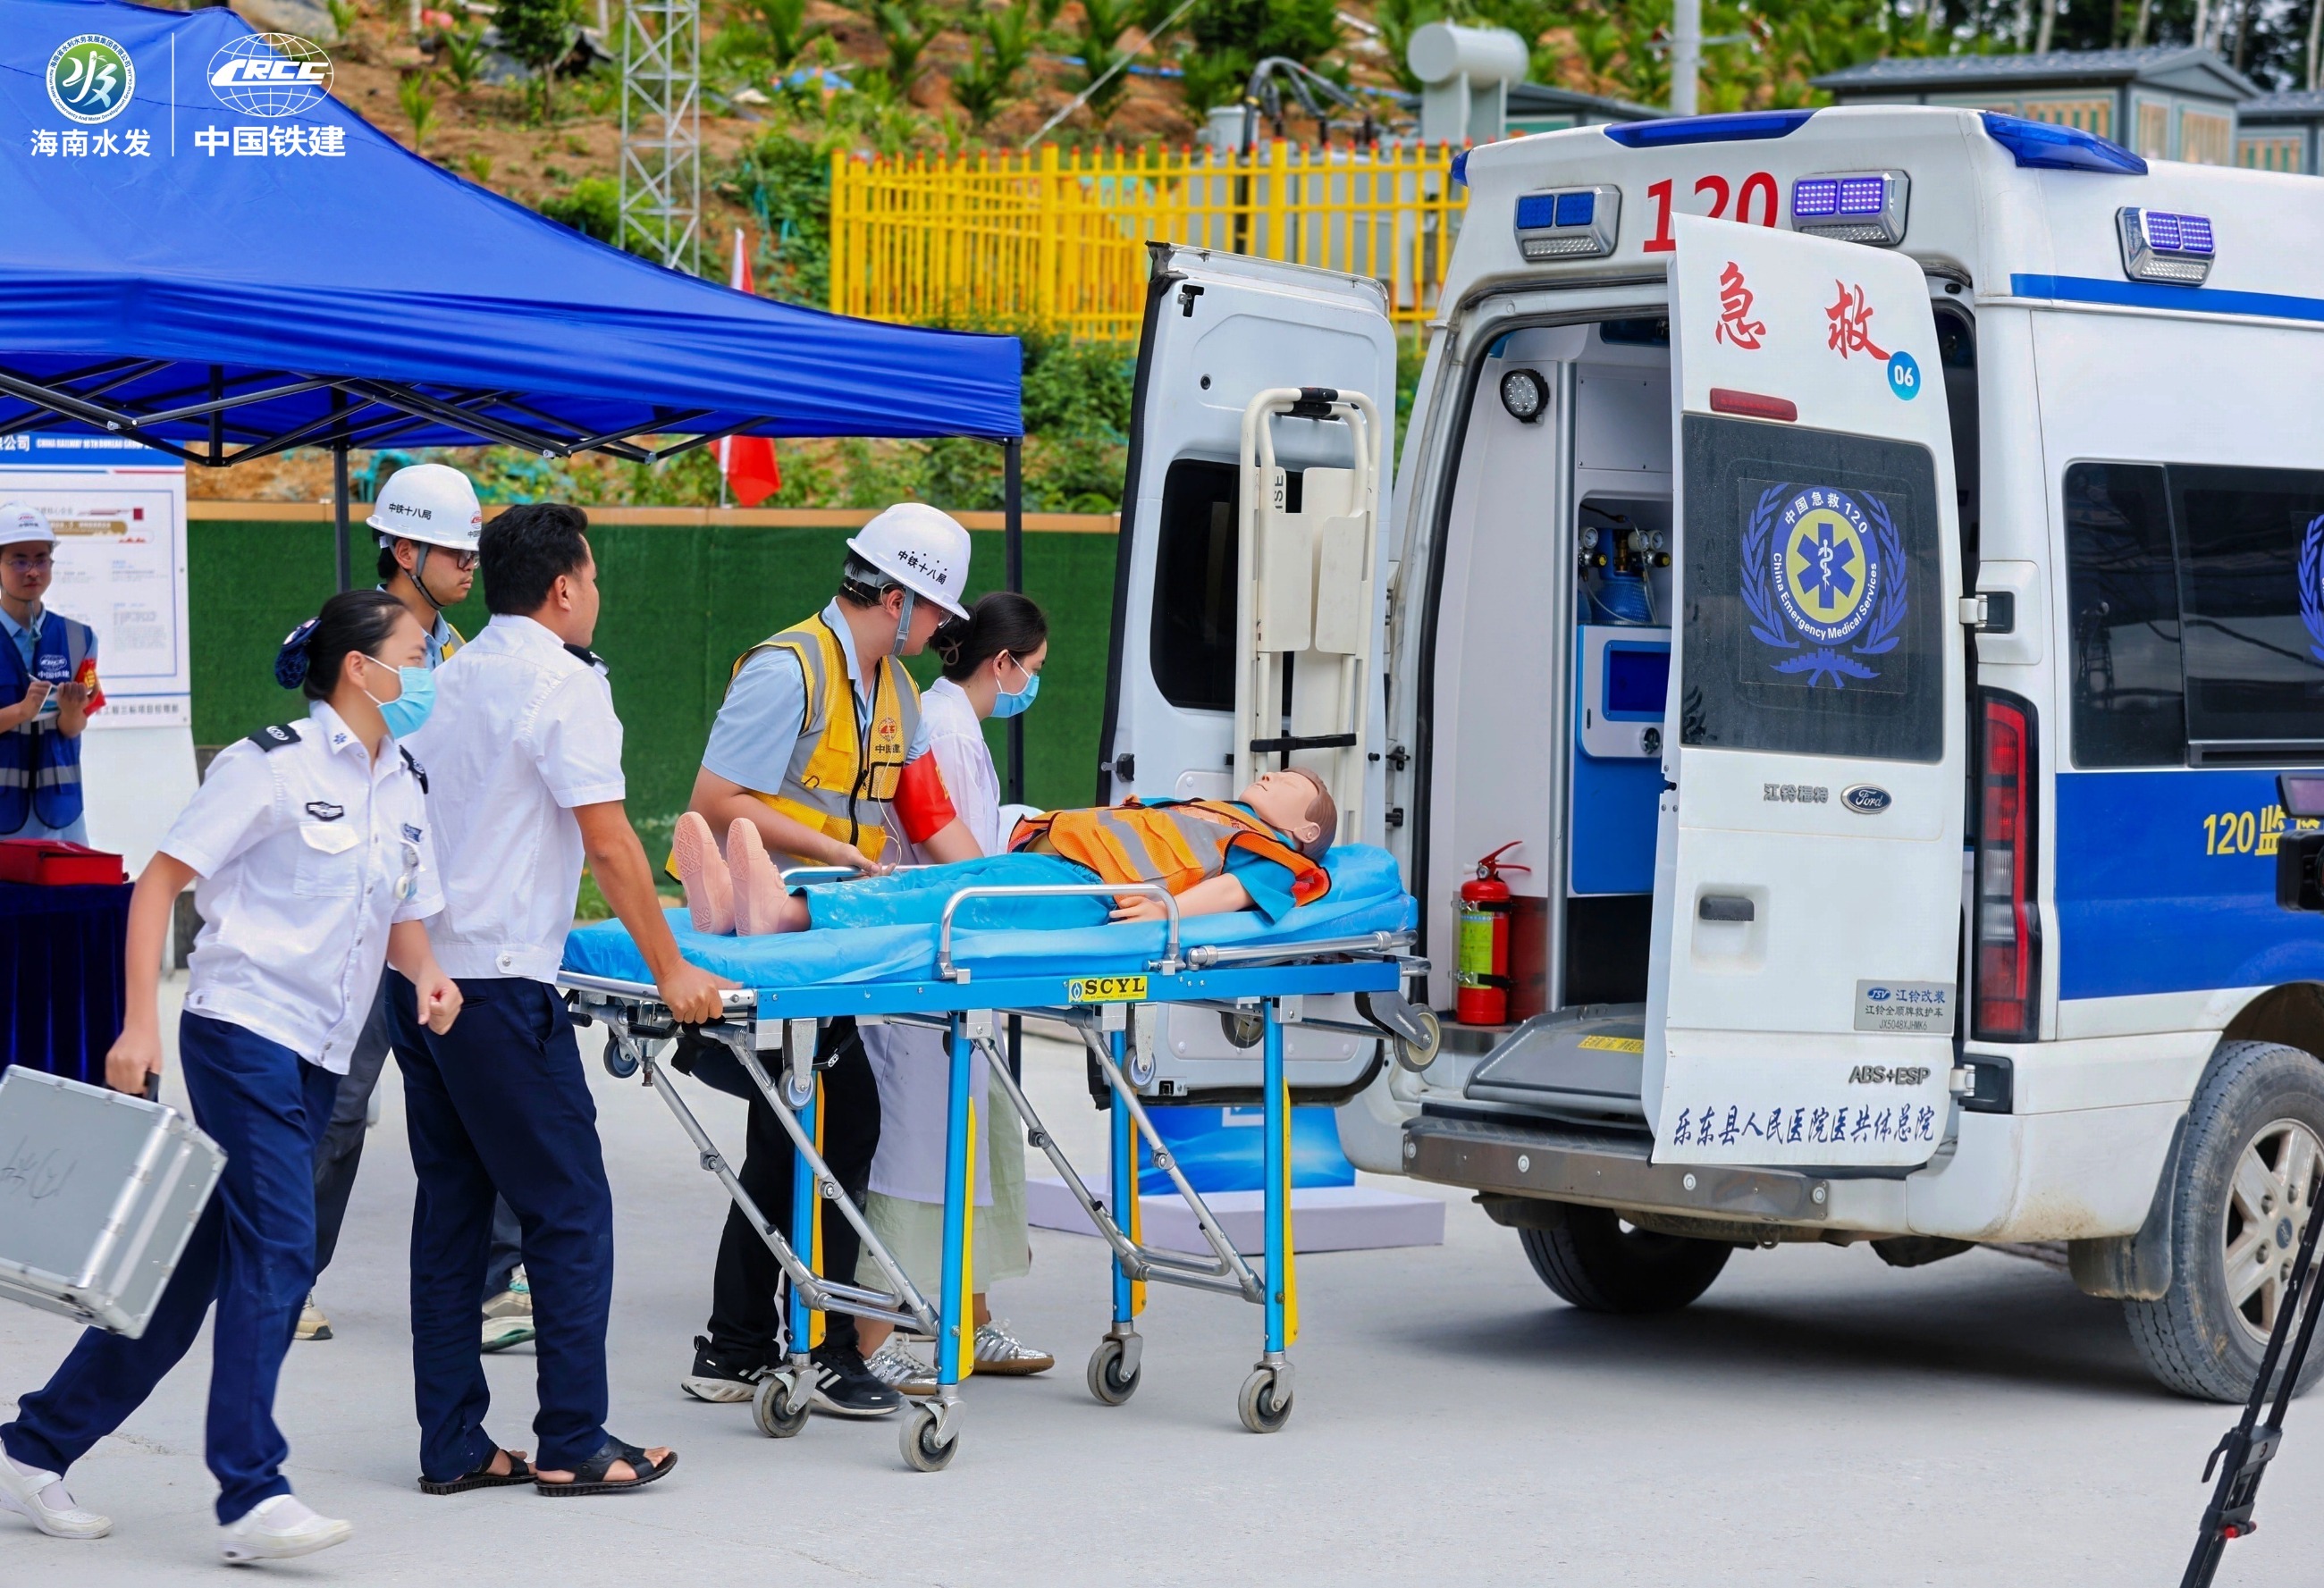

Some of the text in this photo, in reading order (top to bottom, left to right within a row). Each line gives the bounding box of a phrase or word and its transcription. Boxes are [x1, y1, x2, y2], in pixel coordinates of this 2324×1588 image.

[1643, 172, 1779, 253] 120
[1715, 261, 1891, 360] 急救
[1893, 365, 1915, 387] 06
[388, 502, 432, 520] 中铁十八局
[897, 550, 947, 585] 中铁十八局
[1773, 552, 1877, 640] China Emergency Medical Services
[1764, 783, 1829, 803] 江铃福特
[1855, 789, 1883, 807] Ford
[1084, 977, 1145, 996] SCYL
[1869, 990, 1890, 999] JSV
[1895, 989, 1946, 1004] 江铃改装
[1865, 1004, 1944, 1018] 江铃全顺牌救护车
[1848, 1065, 1932, 1086] ABS+ESP
[1673, 1104, 1935, 1147] 乐东县人民医院医共体总院
